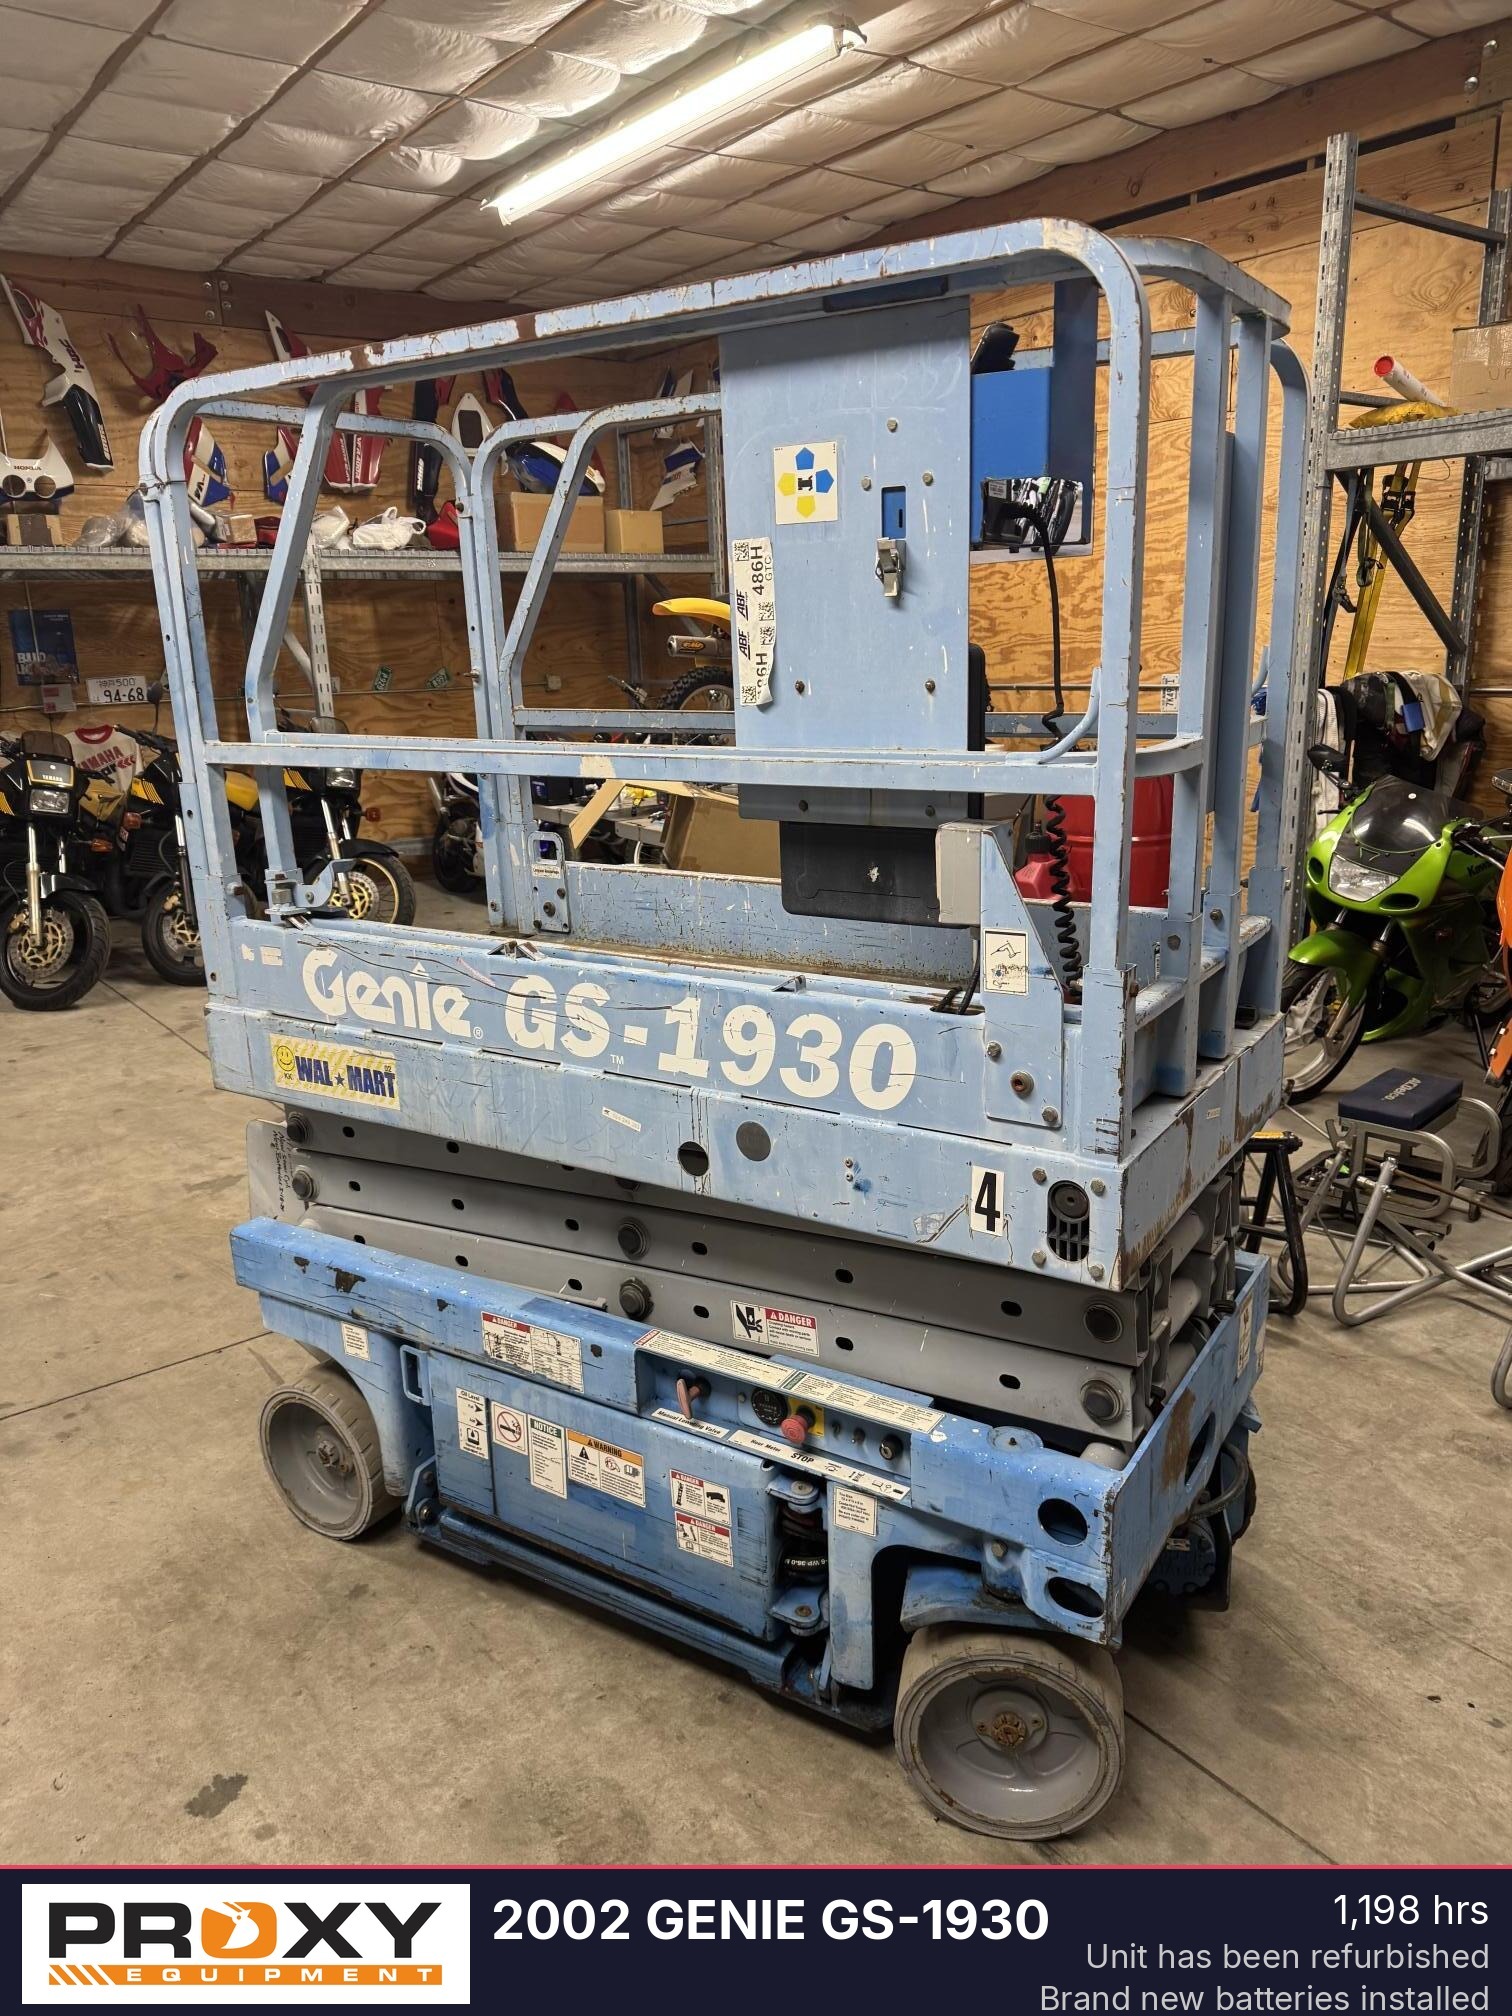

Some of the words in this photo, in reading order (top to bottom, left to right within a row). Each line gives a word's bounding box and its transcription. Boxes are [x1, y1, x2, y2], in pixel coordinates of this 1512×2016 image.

[751, 545, 764, 596] 486H
[765, 556, 773, 581] GTC
[736, 590, 747, 617] ABF
[738, 629, 748, 656] ABF
[756, 652, 768, 695] 86H
[103, 687, 145, 703] 94-68
[42, 774, 63, 782] YAMAHA
[302, 948, 471, 1038] Genie
[505, 974, 917, 1111] GS-1930
[295, 1056, 333, 1086] WAL
[346, 1065, 396, 1098] MART
[974, 1171, 1001, 1232] 4
[778, 1311, 813, 1327] DANGER
[533, 1420, 559, 1437] NOTICE
[657, 1411, 679, 1421] Manual
[705, 1425, 721, 1434] Valve
[593, 1441, 622, 1458] WARNING
[765, 1443, 781, 1452] Meter
[790, 1452, 815, 1463] STOP
